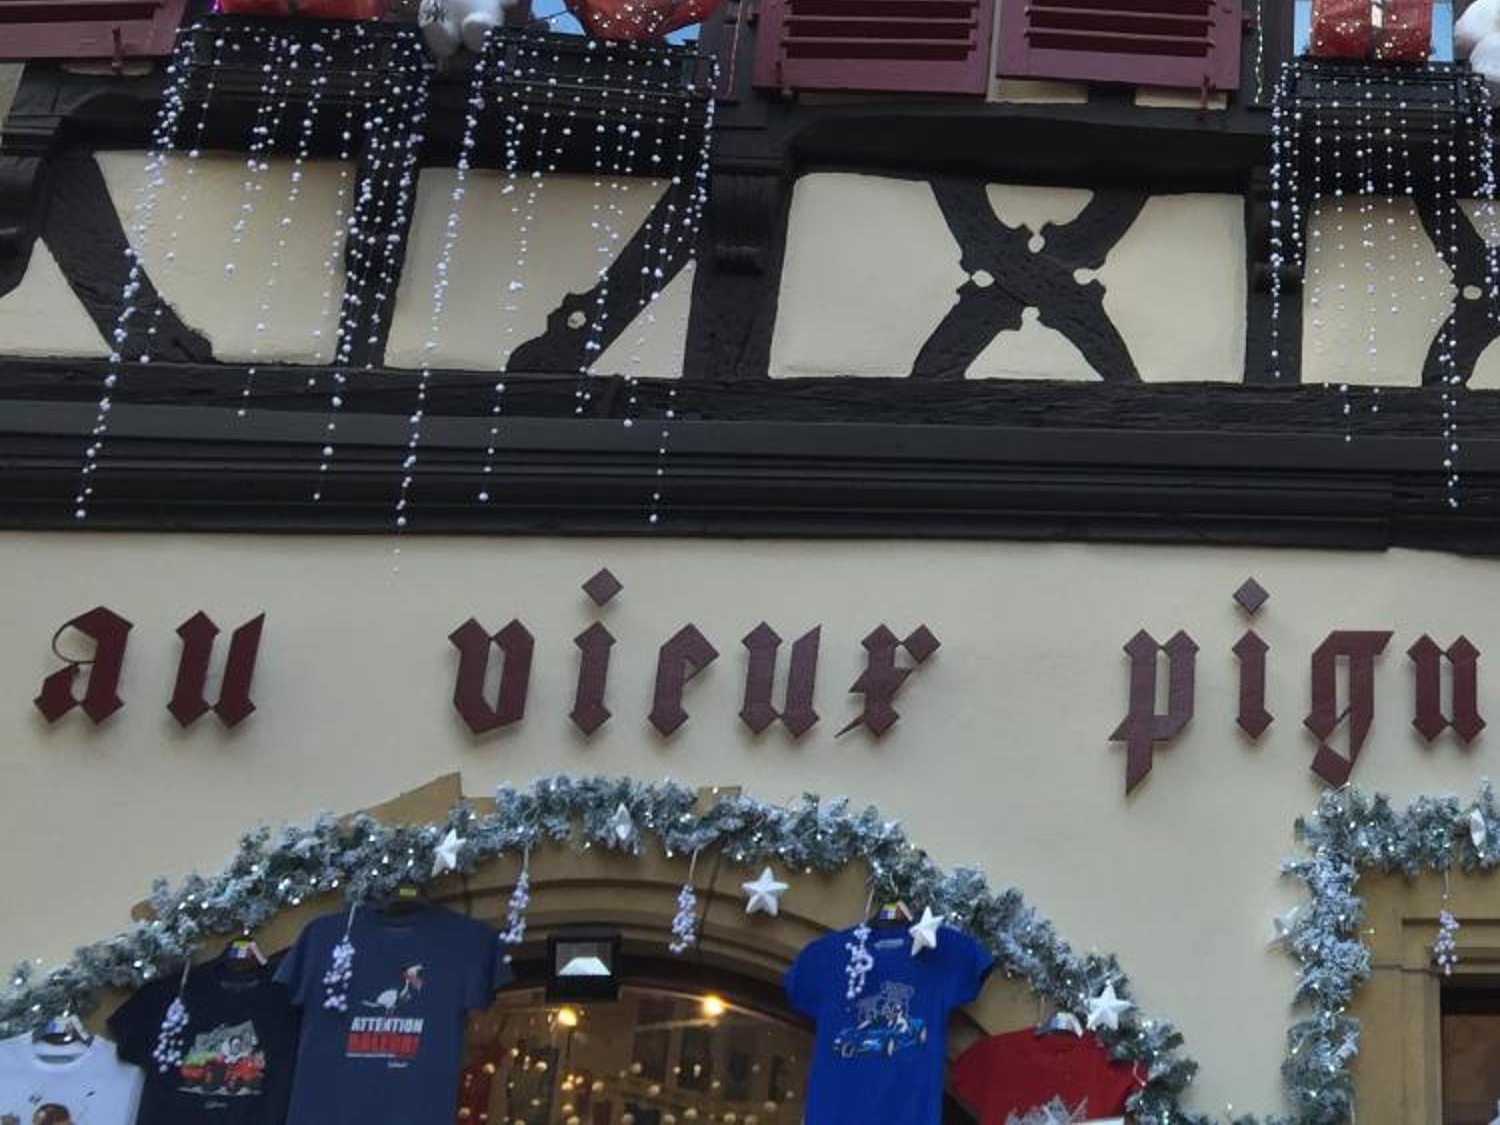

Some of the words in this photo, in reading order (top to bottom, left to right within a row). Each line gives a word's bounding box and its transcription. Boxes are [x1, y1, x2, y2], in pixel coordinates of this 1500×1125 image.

[34, 606, 265, 728] au
[448, 567, 941, 738] vieux
[351, 1016, 424, 1033] ATTENTION
